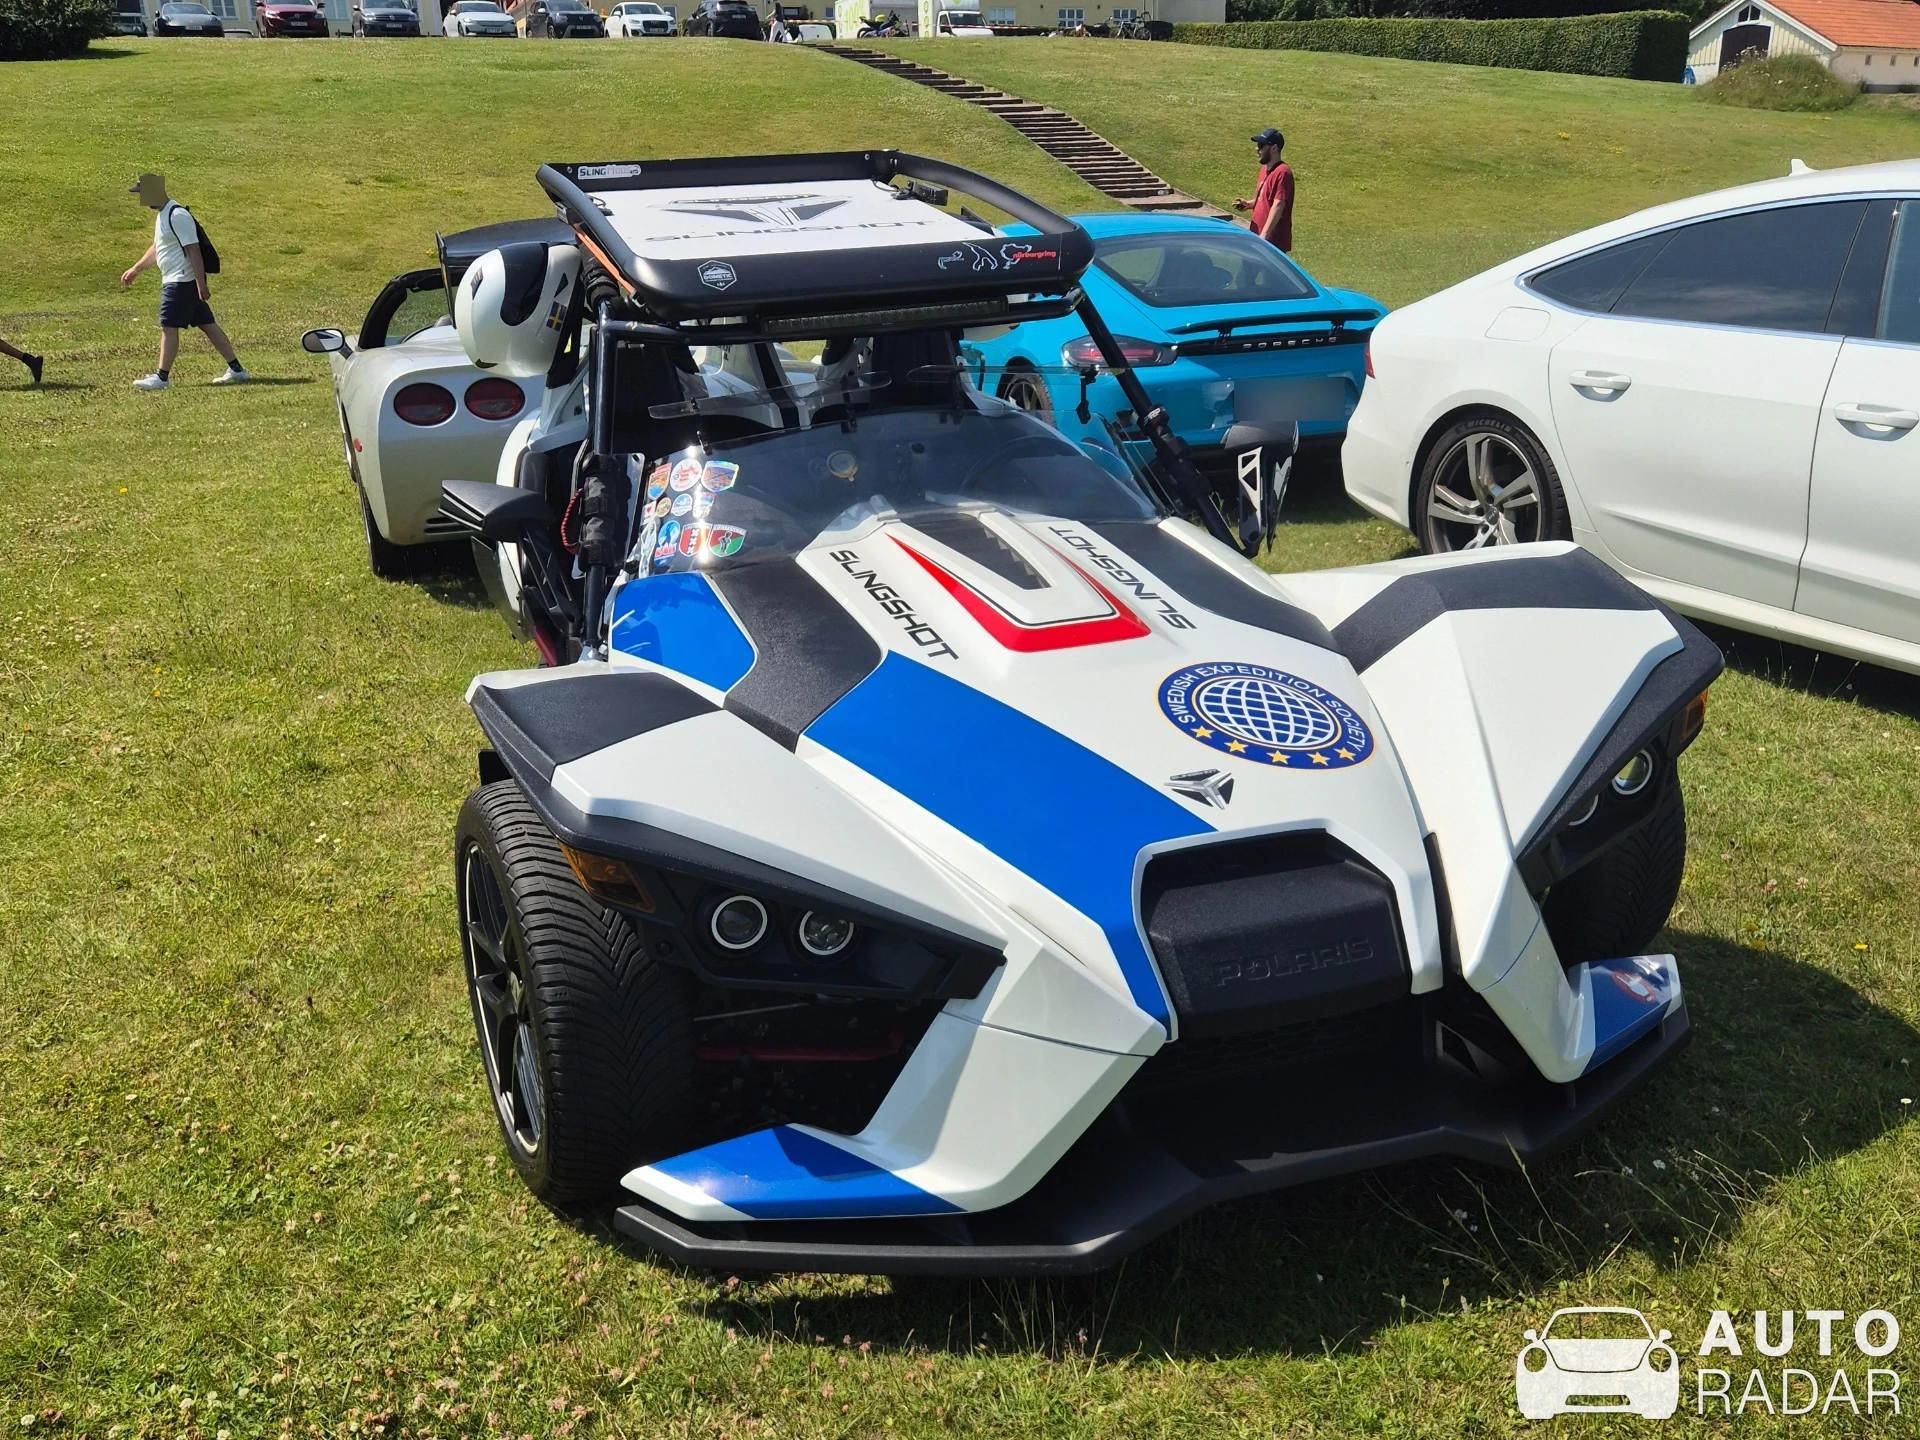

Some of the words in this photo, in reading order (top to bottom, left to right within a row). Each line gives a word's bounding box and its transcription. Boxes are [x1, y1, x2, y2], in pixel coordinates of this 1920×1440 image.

[645, 220, 935, 242] SLINGSHOT
[1012, 250, 1057, 259] nürburgring
[1242, 336, 1337, 349] PORSCHE
[1467, 419, 1512, 433] MICHELIN
[1048, 526, 1198, 630] SLINGSHOT
[829, 550, 959, 661] SLINGSHOT
[1167, 673, 1200, 724] SWEDISH
[1195, 664, 1326, 699] EXPEDITION
[1325, 699, 1366, 752] SOCIETY
[1214, 937, 1374, 987] POLARIS
